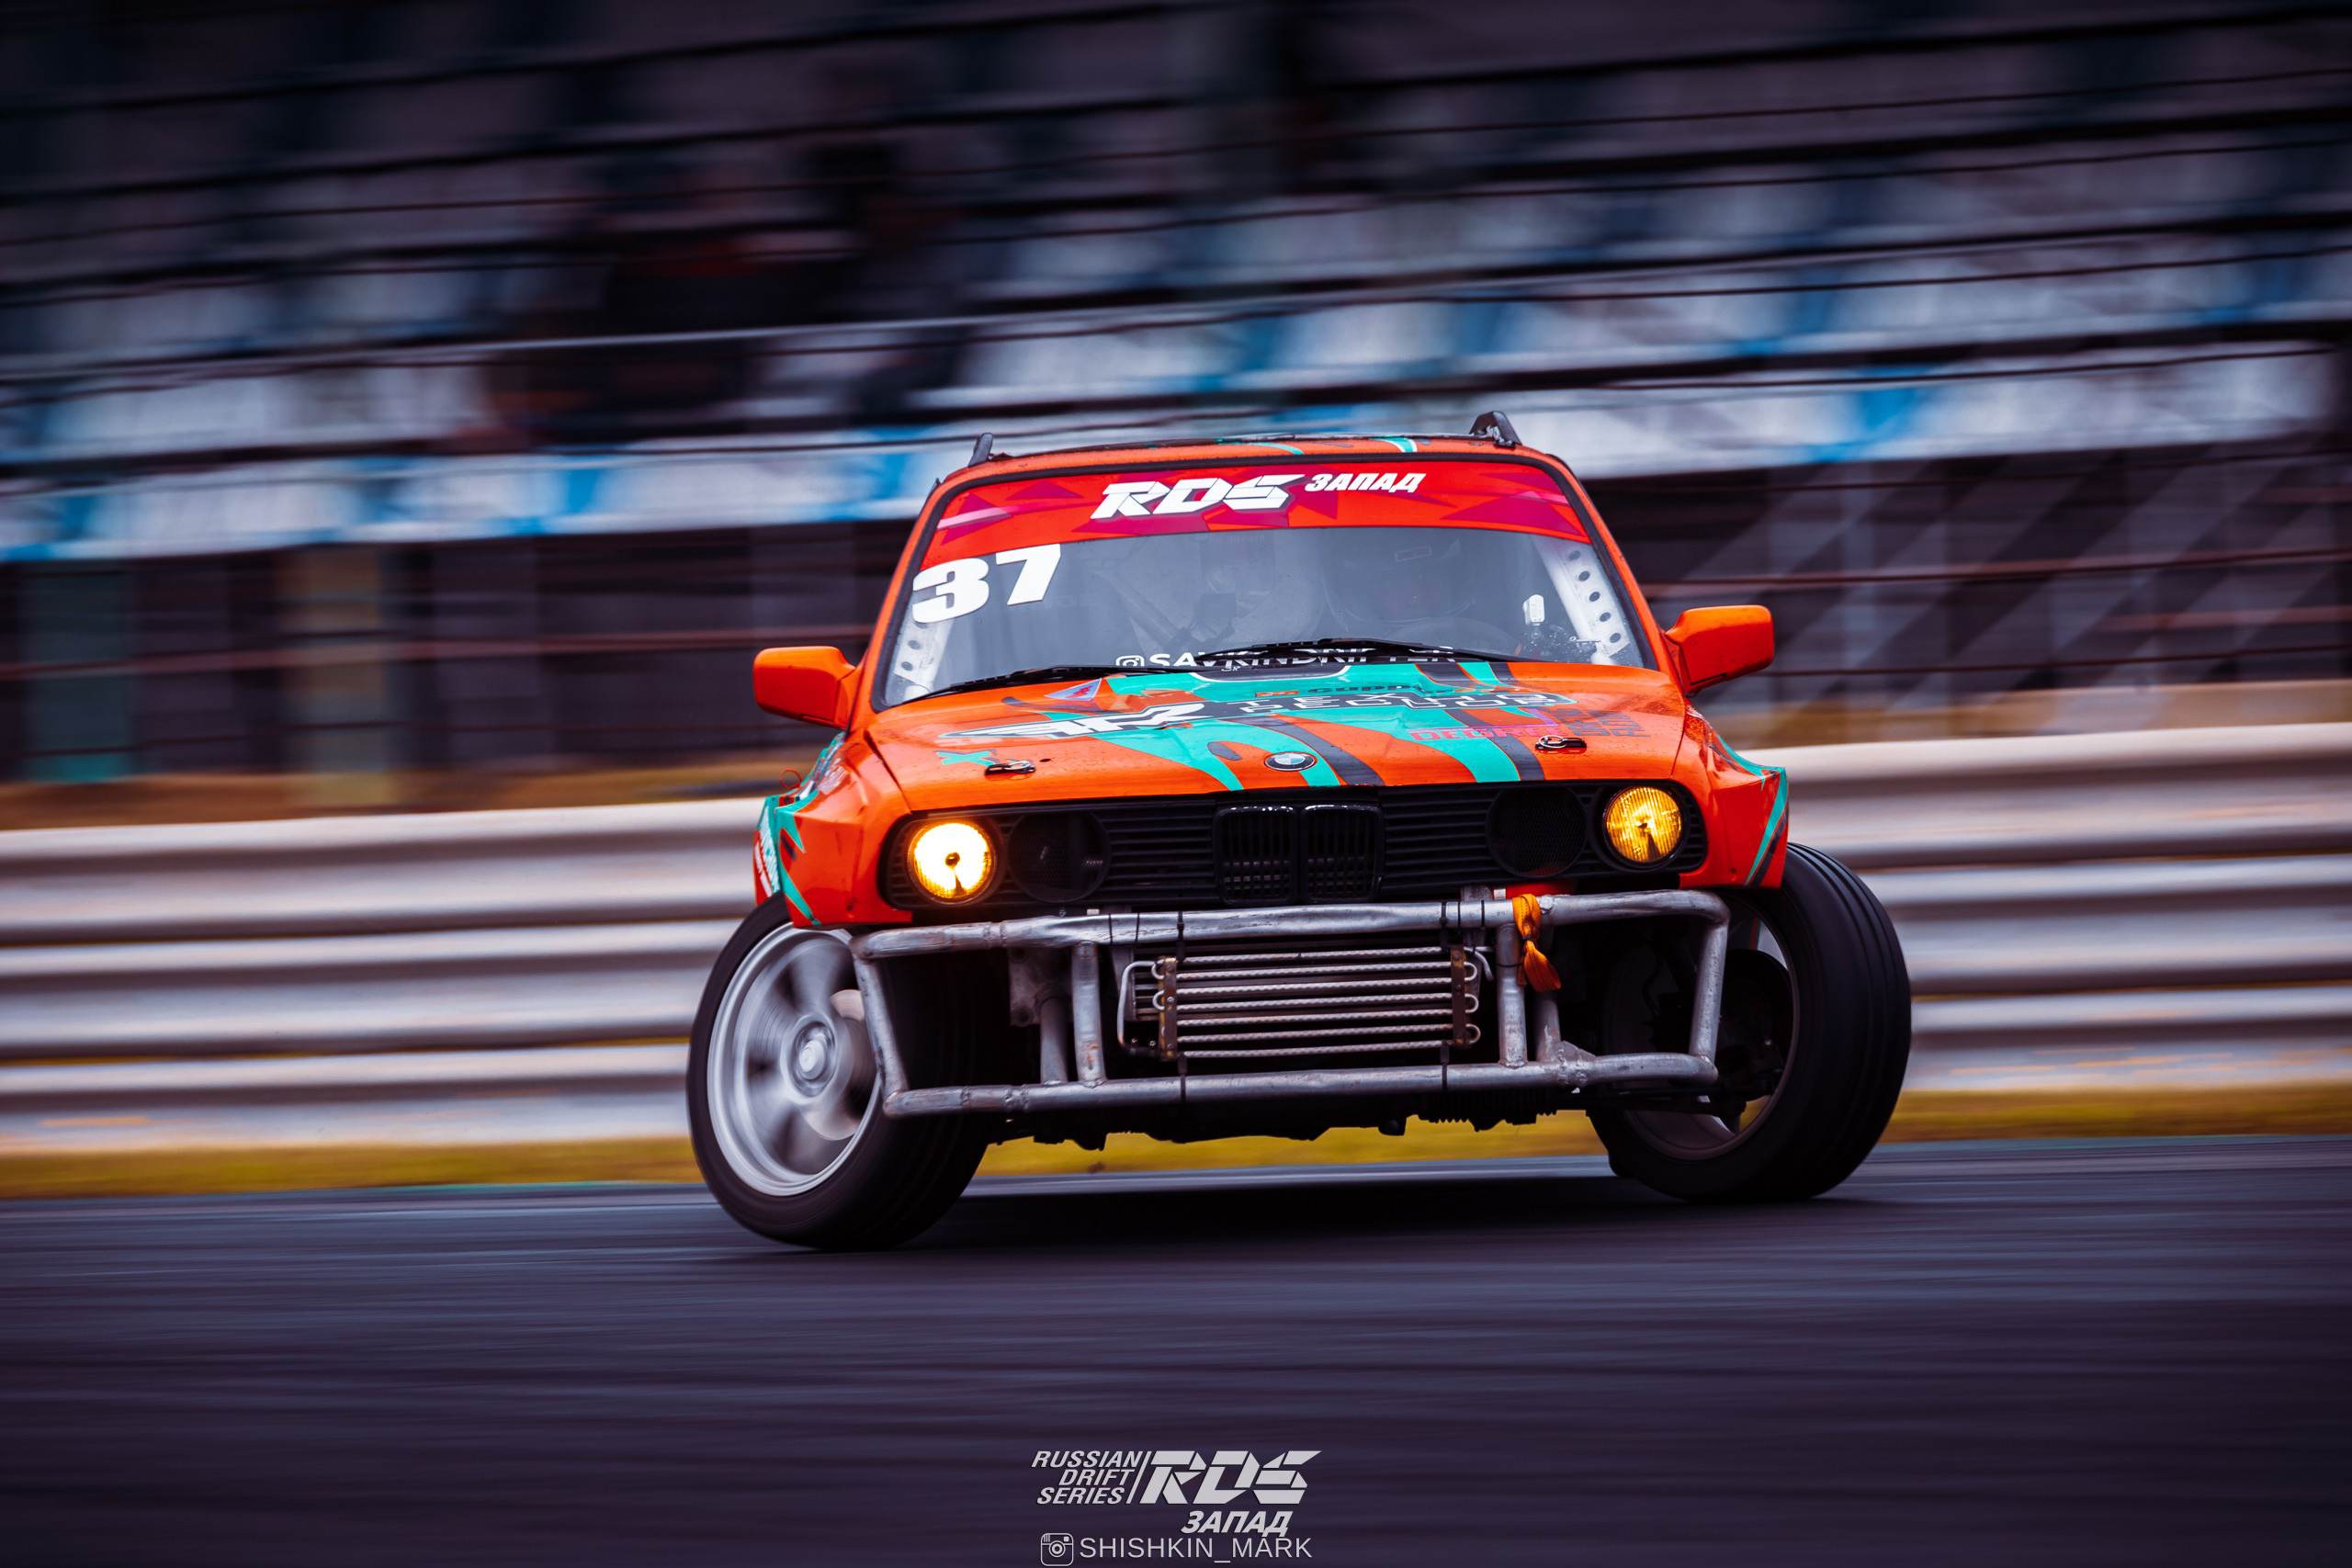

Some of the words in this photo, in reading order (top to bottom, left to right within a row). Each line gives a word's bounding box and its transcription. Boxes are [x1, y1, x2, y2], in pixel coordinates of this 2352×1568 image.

[1090, 473, 1306, 519] RDS
[1304, 472, 1427, 493] ЗАПАД
[912, 543, 1061, 624] 37
[1409, 727, 1568, 741] DEGREE
